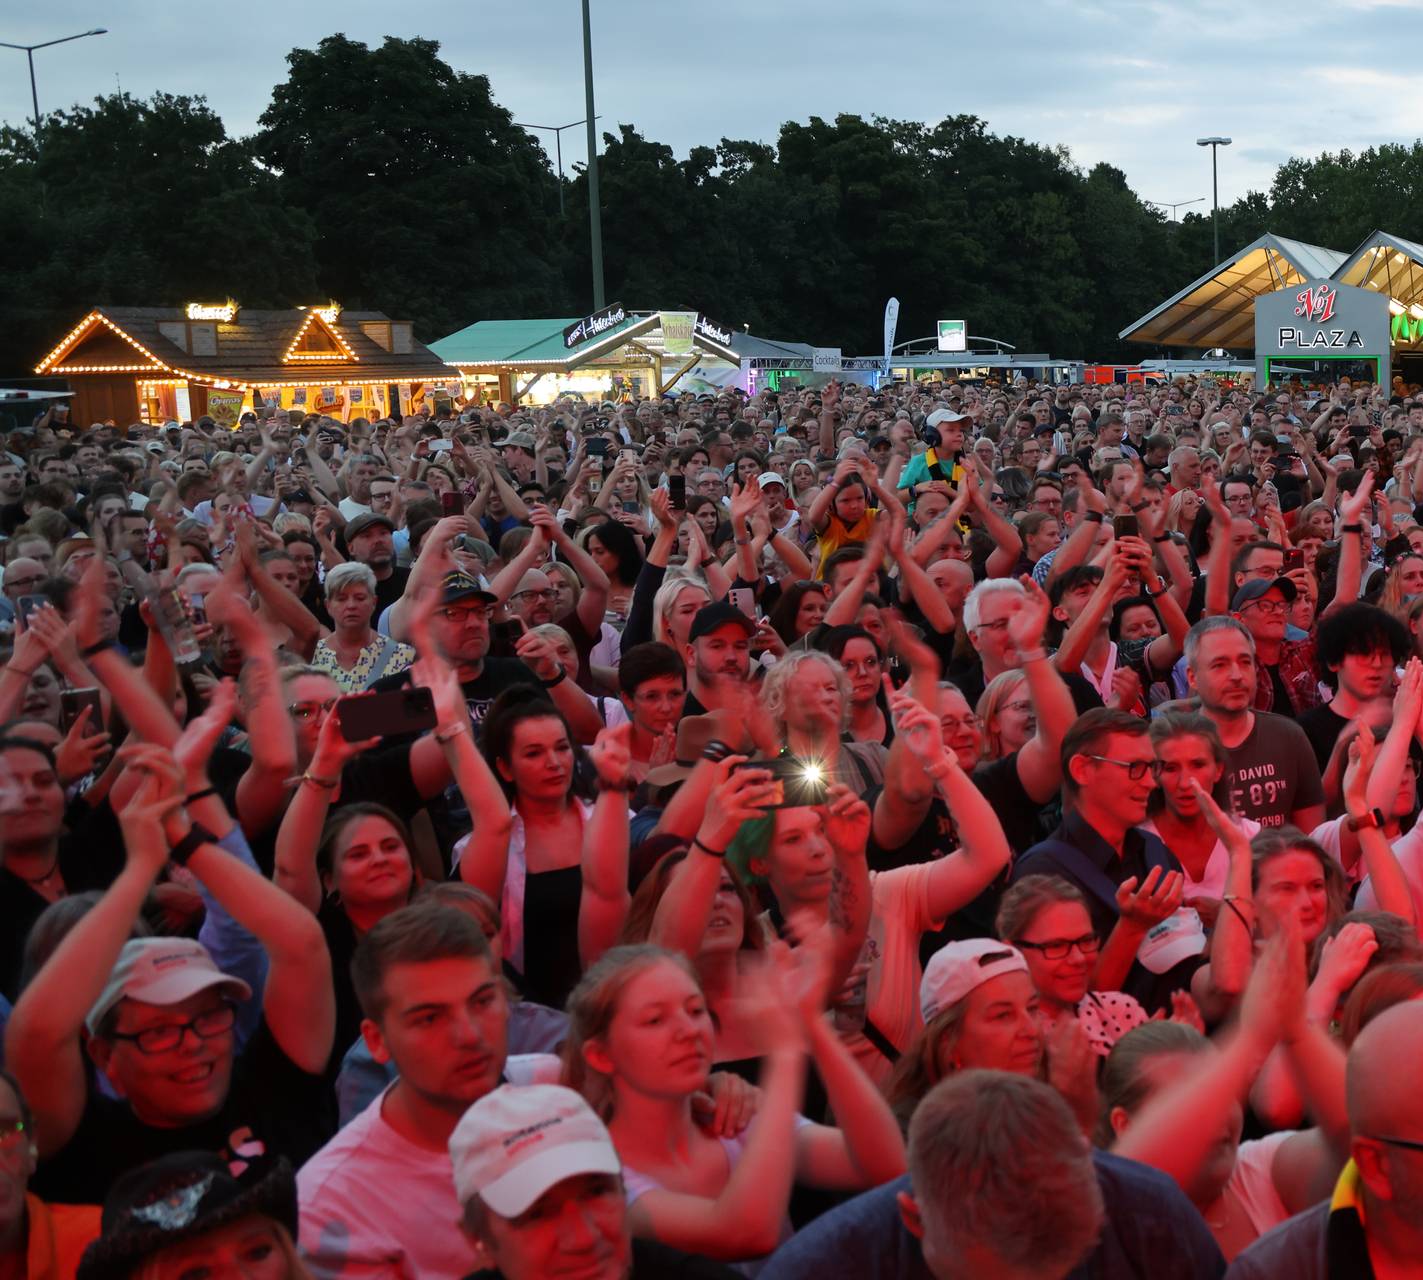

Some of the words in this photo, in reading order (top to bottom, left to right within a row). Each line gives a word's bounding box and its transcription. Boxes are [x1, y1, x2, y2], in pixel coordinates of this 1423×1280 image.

[1278, 326, 1364, 348] PLAZA
[814, 354, 840, 366] Cocktails
[1239, 763, 1275, 781] DAVID
